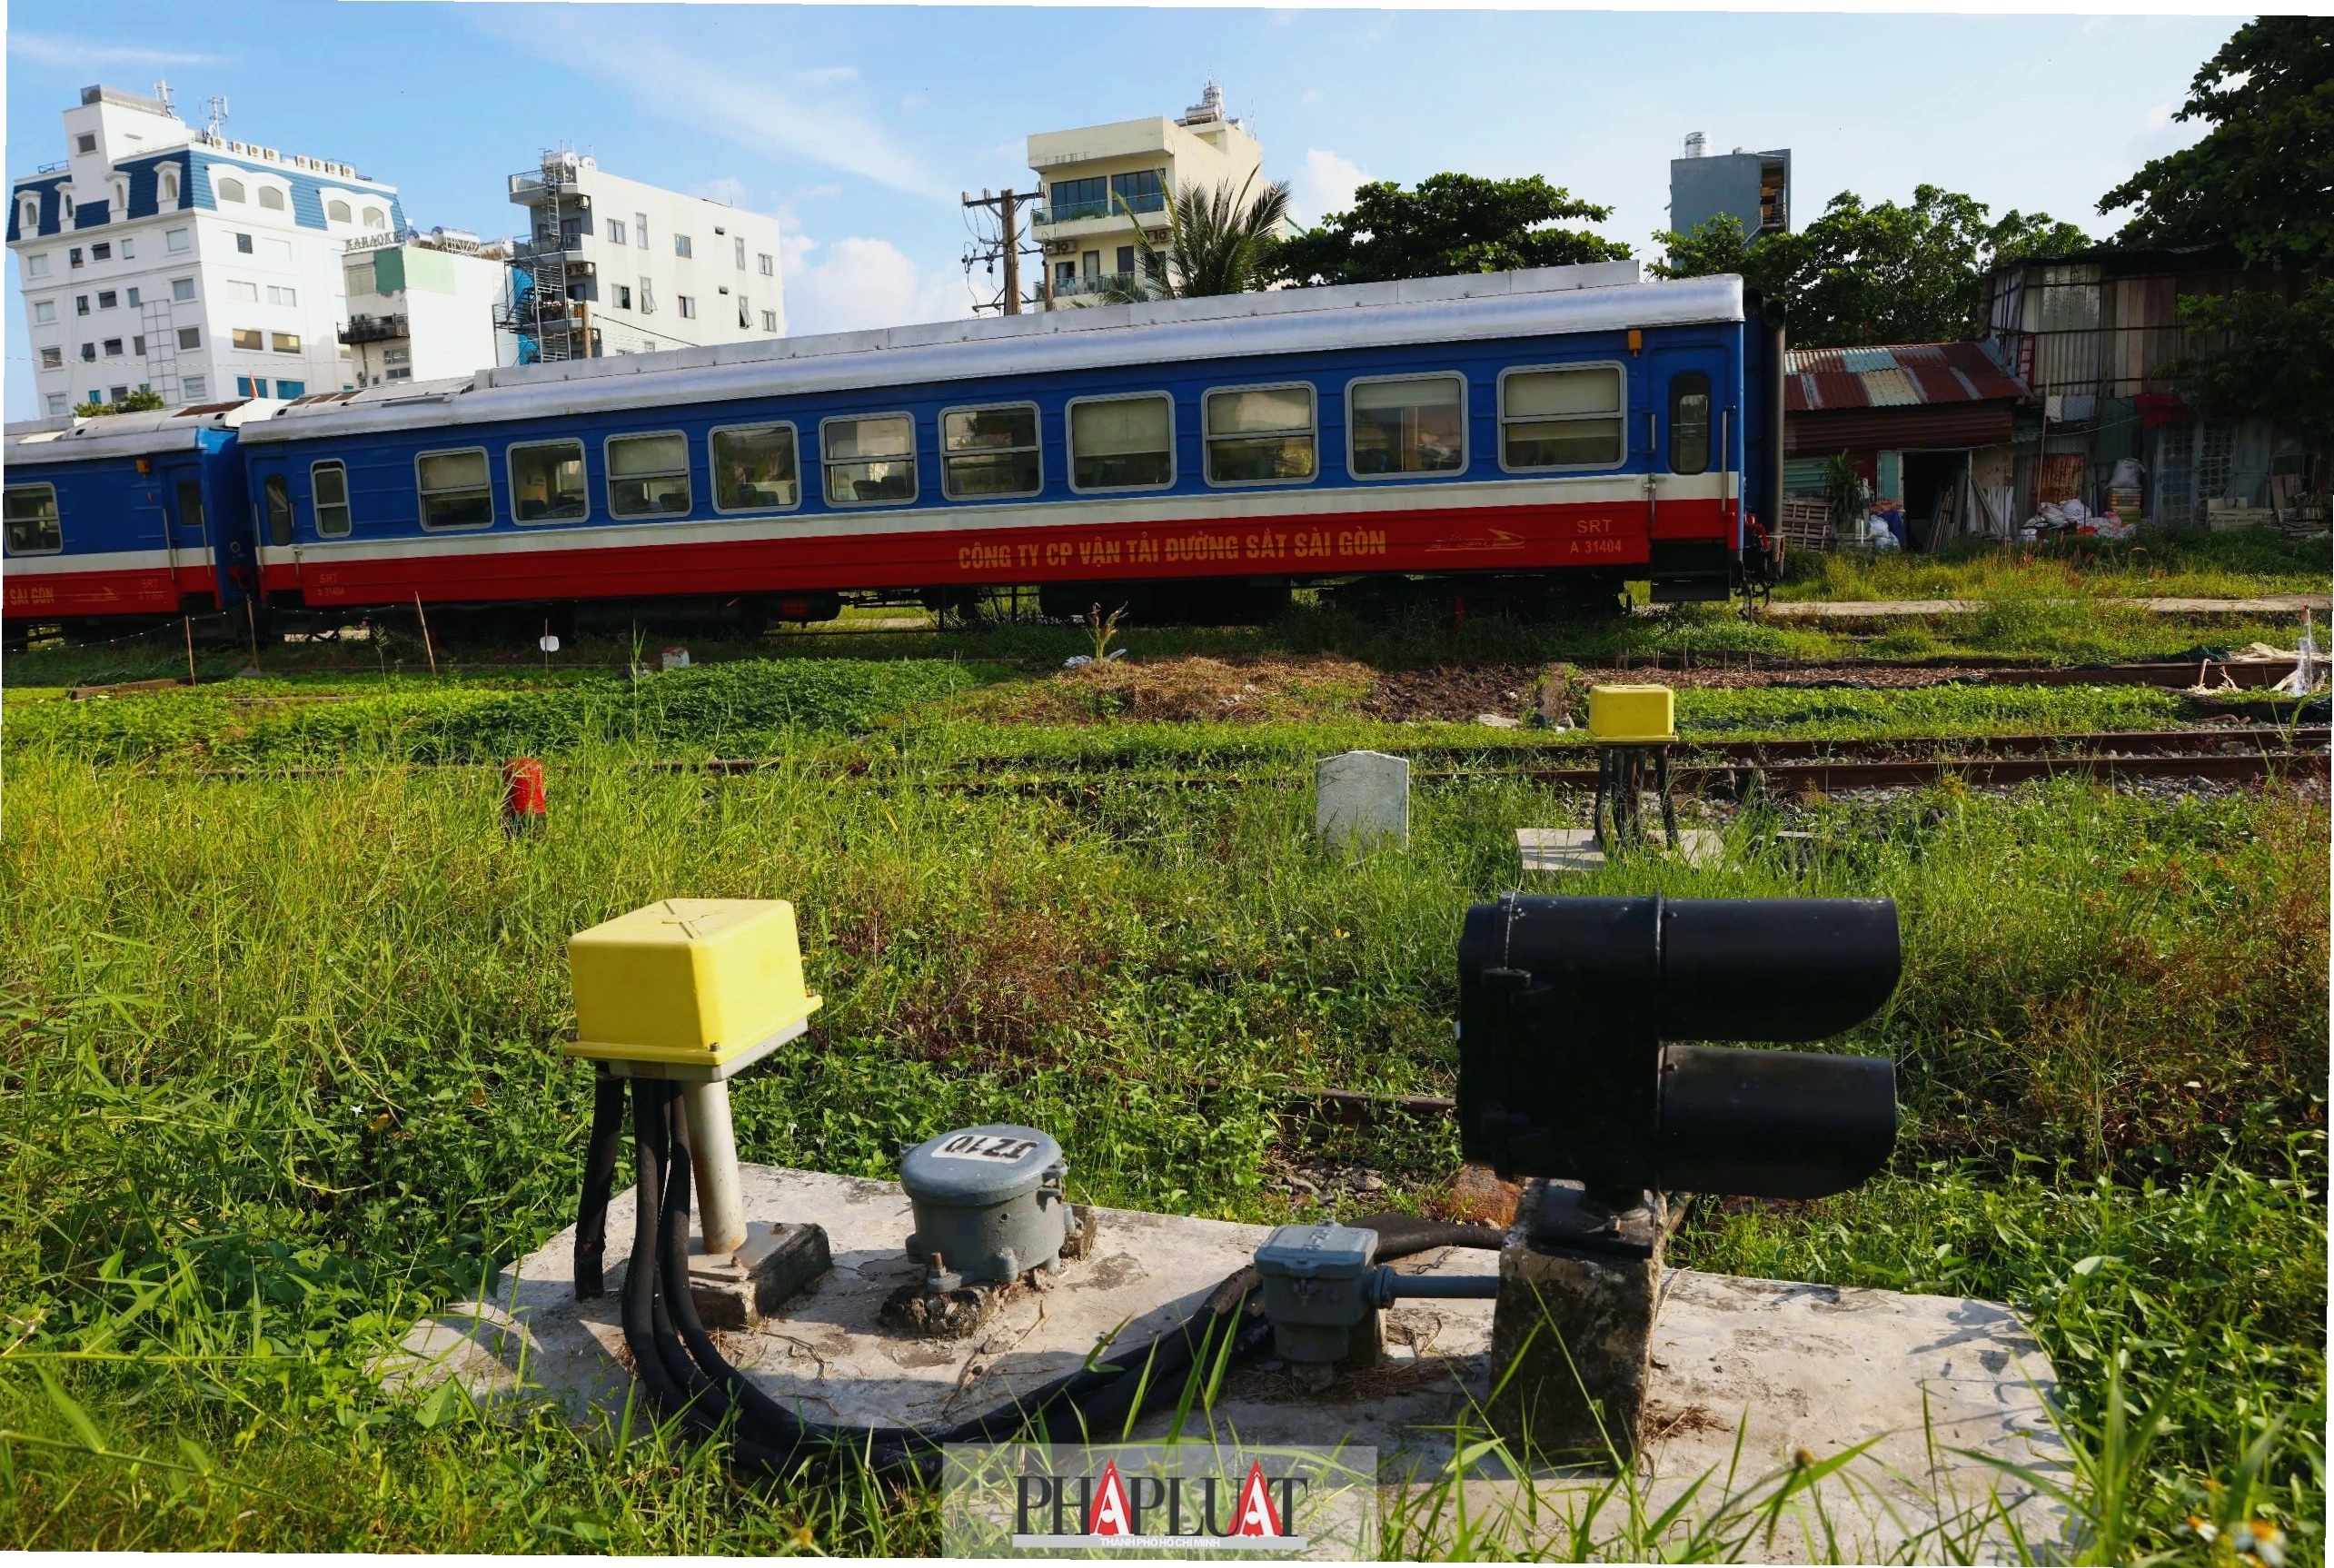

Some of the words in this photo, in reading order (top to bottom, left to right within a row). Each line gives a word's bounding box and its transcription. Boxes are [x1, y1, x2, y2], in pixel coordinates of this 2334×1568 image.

[1577, 520, 1612, 533] SRT
[958, 541, 1012, 569] CÔNG
[1018, 543, 1039, 567] TY
[1046, 542, 1073, 566] CP
[1079, 537, 1120, 567] VẬN
[1126, 531, 1158, 562] TẢI
[1165, 531, 1239, 561] ĐƯỜNG
[1246, 527, 1287, 559] SẮT
[1295, 527, 1331, 558] SÀI
[1338, 525, 1386, 556] GÒN
[1570, 541, 1579, 554] A
[1584, 540, 1622, 554] 31404
[141, 579, 159, 589] SRT
[319, 573, 338, 584] SRT
